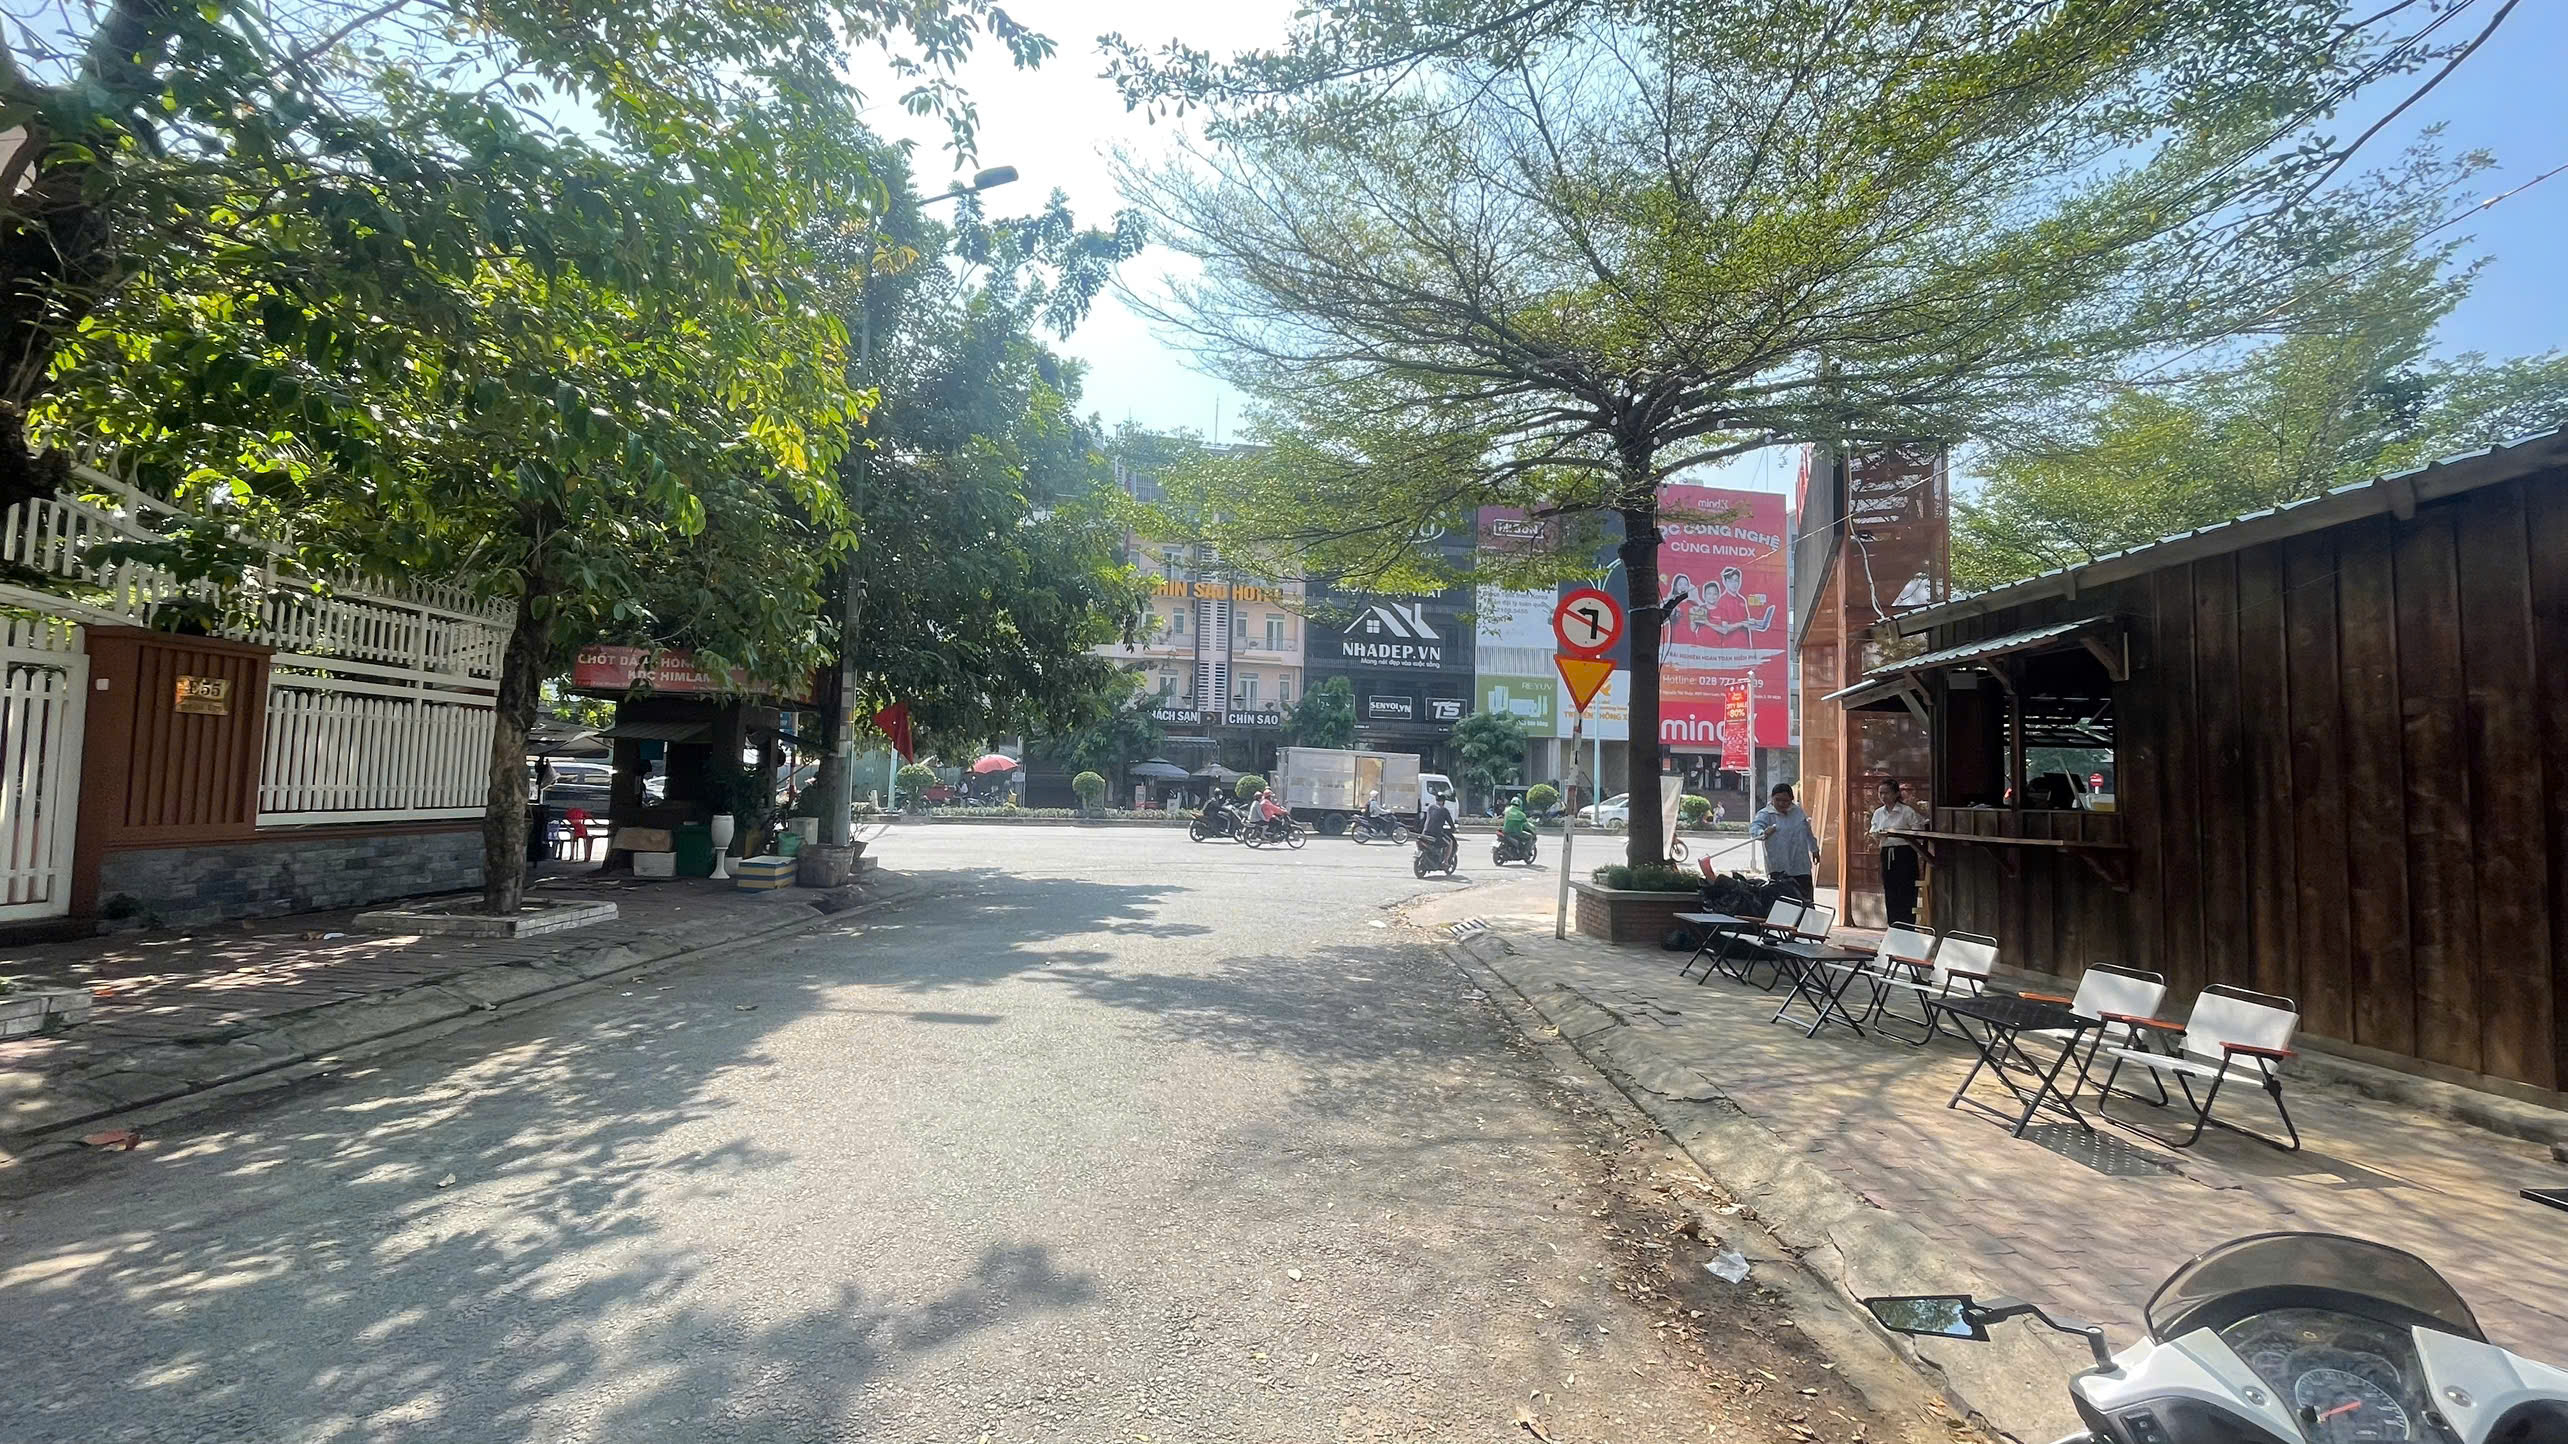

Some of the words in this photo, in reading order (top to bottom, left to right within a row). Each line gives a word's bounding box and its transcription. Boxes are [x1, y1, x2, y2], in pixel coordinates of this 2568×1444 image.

[1657, 525, 1681, 540] ỌC
[1670, 540, 1711, 554] CÙNG
[1712, 545, 1757, 557] MINDX
[1153, 581, 1186, 597] HIN
[1342, 642, 1441, 661] NHADEP.VN
[1698, 676, 1718, 686] 028
[1151, 708, 1176, 721] HÁCH
[1177, 710, 1198, 723] SẠN
[1228, 712, 1255, 724] CHÍN
[1256, 714, 1279, 725] SAO
